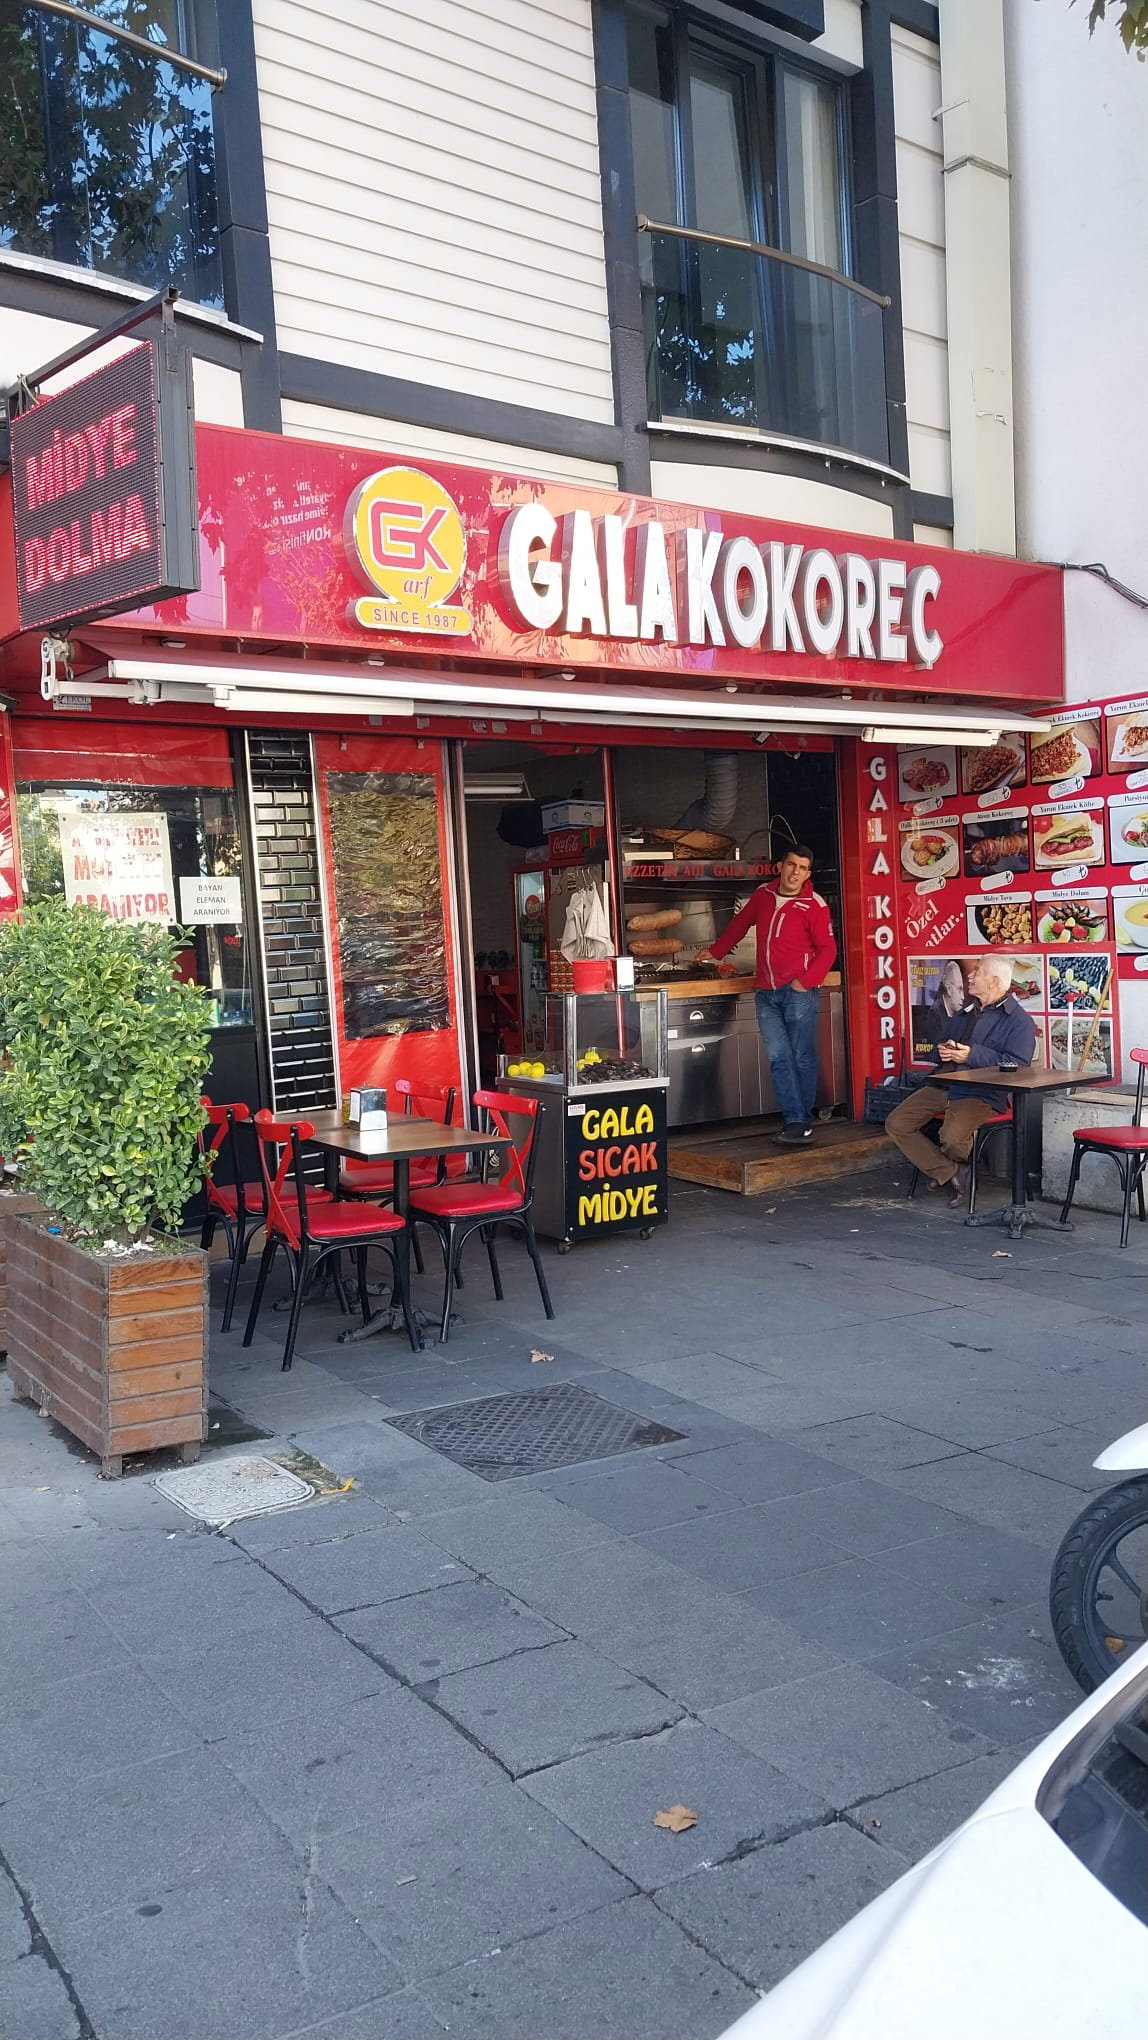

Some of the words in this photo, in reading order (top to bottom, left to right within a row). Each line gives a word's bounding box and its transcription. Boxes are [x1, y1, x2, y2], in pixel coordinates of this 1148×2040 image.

[25, 402, 137, 511] MİDYE
[24, 493, 151, 593] DOLMA
[403, 575, 433, 600] arf
[500, 502, 677, 644] GALA
[373, 606, 420, 625] SİNCE
[425, 613, 458, 628] 1987
[869, 756, 890, 877] GALA
[198, 884, 223, 892] BAYAN
[747, 863, 780, 877] KOKO
[193, 909, 231, 917] ARANIYOR
[196, 896, 226, 904] ELEMAN
[906, 900, 939, 939] Özel
[582, 1104, 654, 1140] GALA
[578, 1141, 659, 1182] SICAK
[578, 1182, 659, 1226] MİDYE
